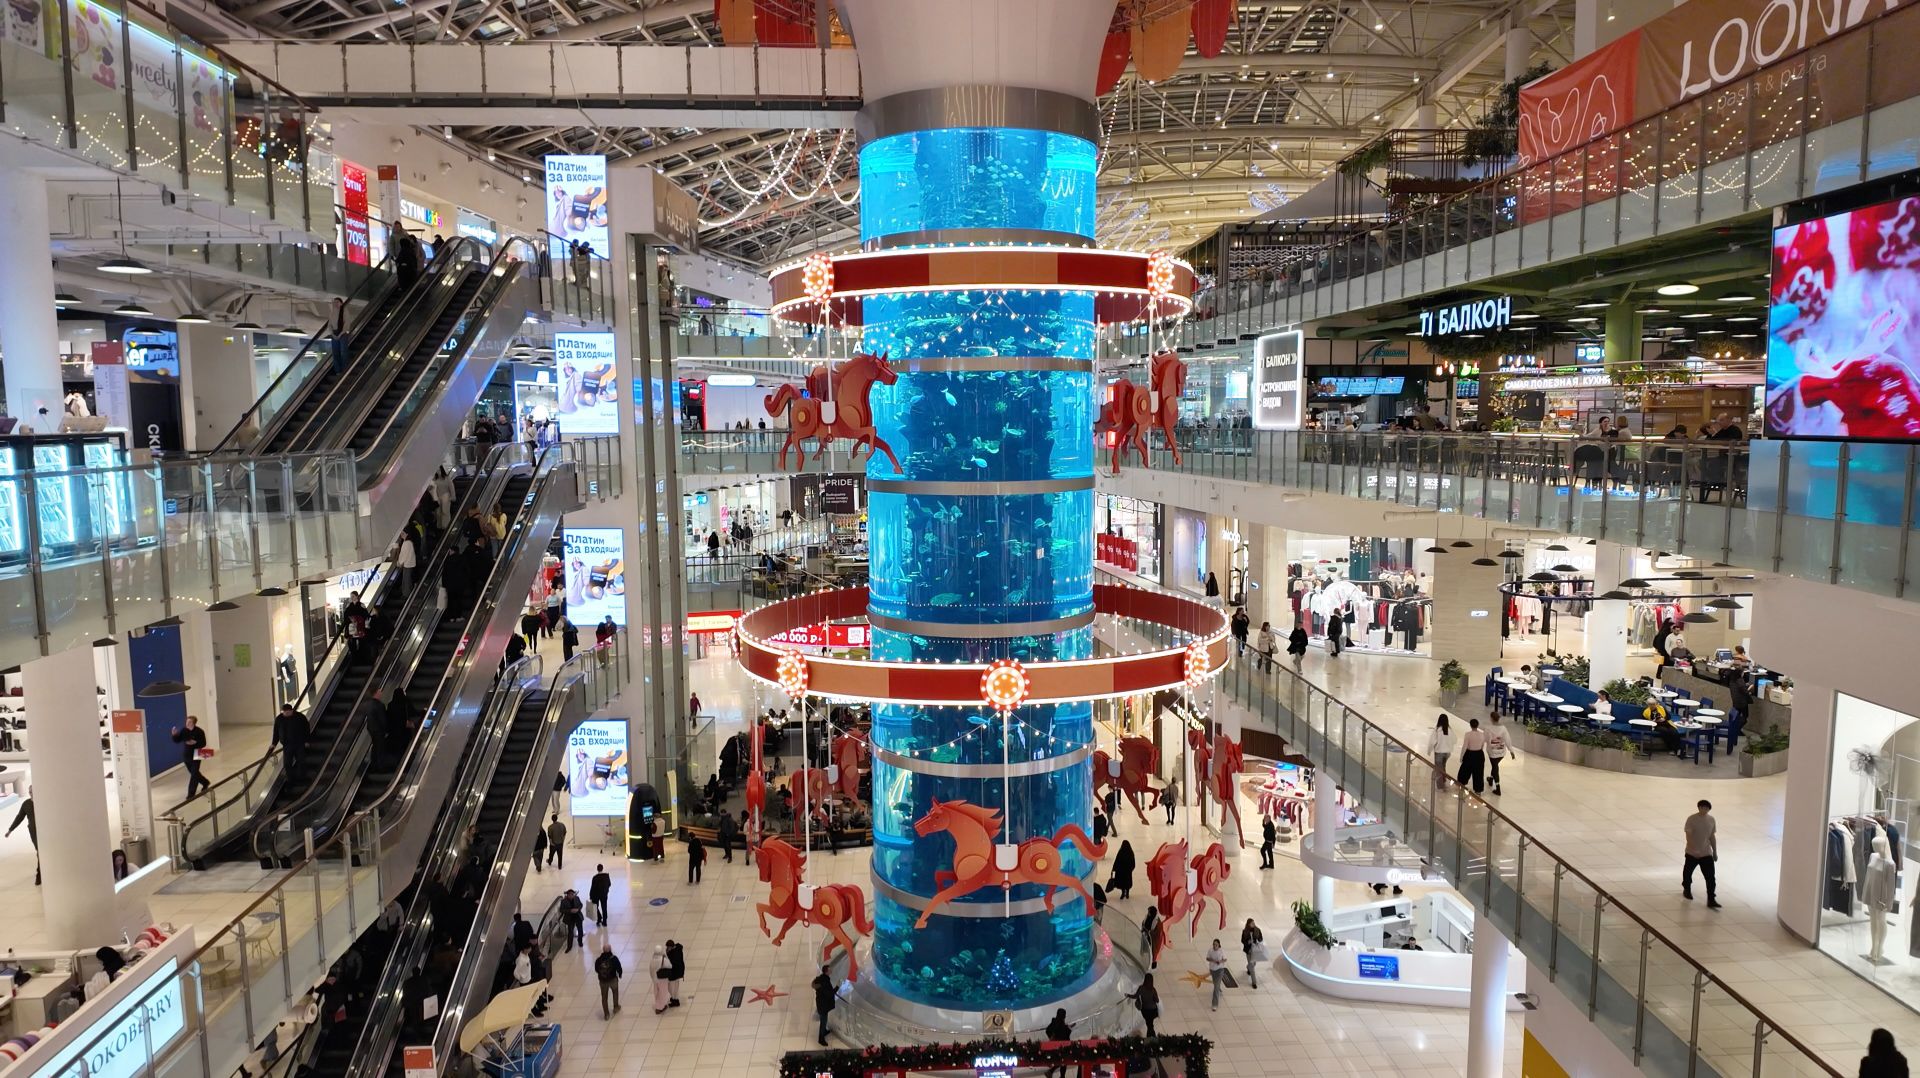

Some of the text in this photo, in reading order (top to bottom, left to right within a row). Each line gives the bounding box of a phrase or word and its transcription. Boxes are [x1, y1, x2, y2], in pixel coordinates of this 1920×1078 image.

[1765, 74, 1774, 92] &
[1439, 296, 1511, 335] БАЛКОН
[1504, 375, 1612, 390] САМАЯ ПОЛЕЗНАЯ КУХНЯ
[825, 478, 853, 486] PRIDE
